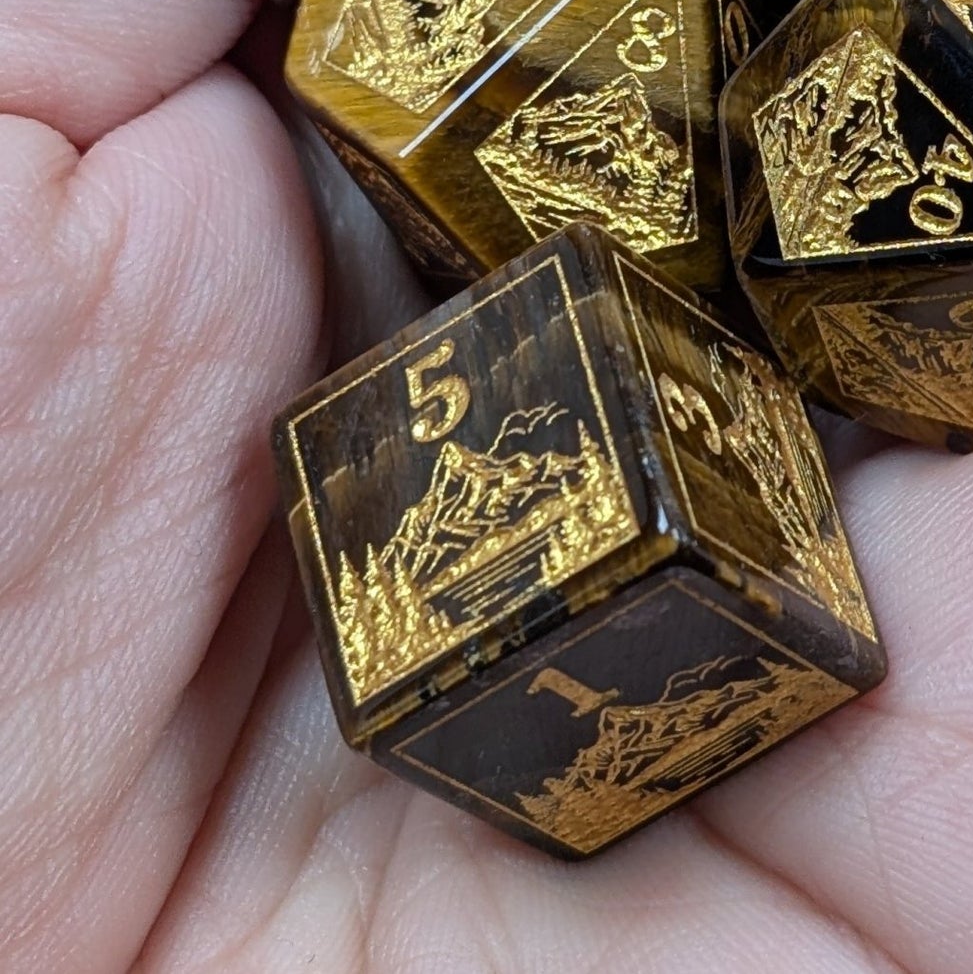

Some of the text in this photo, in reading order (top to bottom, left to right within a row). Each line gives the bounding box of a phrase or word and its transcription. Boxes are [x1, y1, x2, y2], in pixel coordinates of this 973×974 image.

[616, 7, 677, 73] 8
[405, 339, 471, 442] 5
[658, 371, 724, 456] 3
[526, 667, 621, 718] 1
